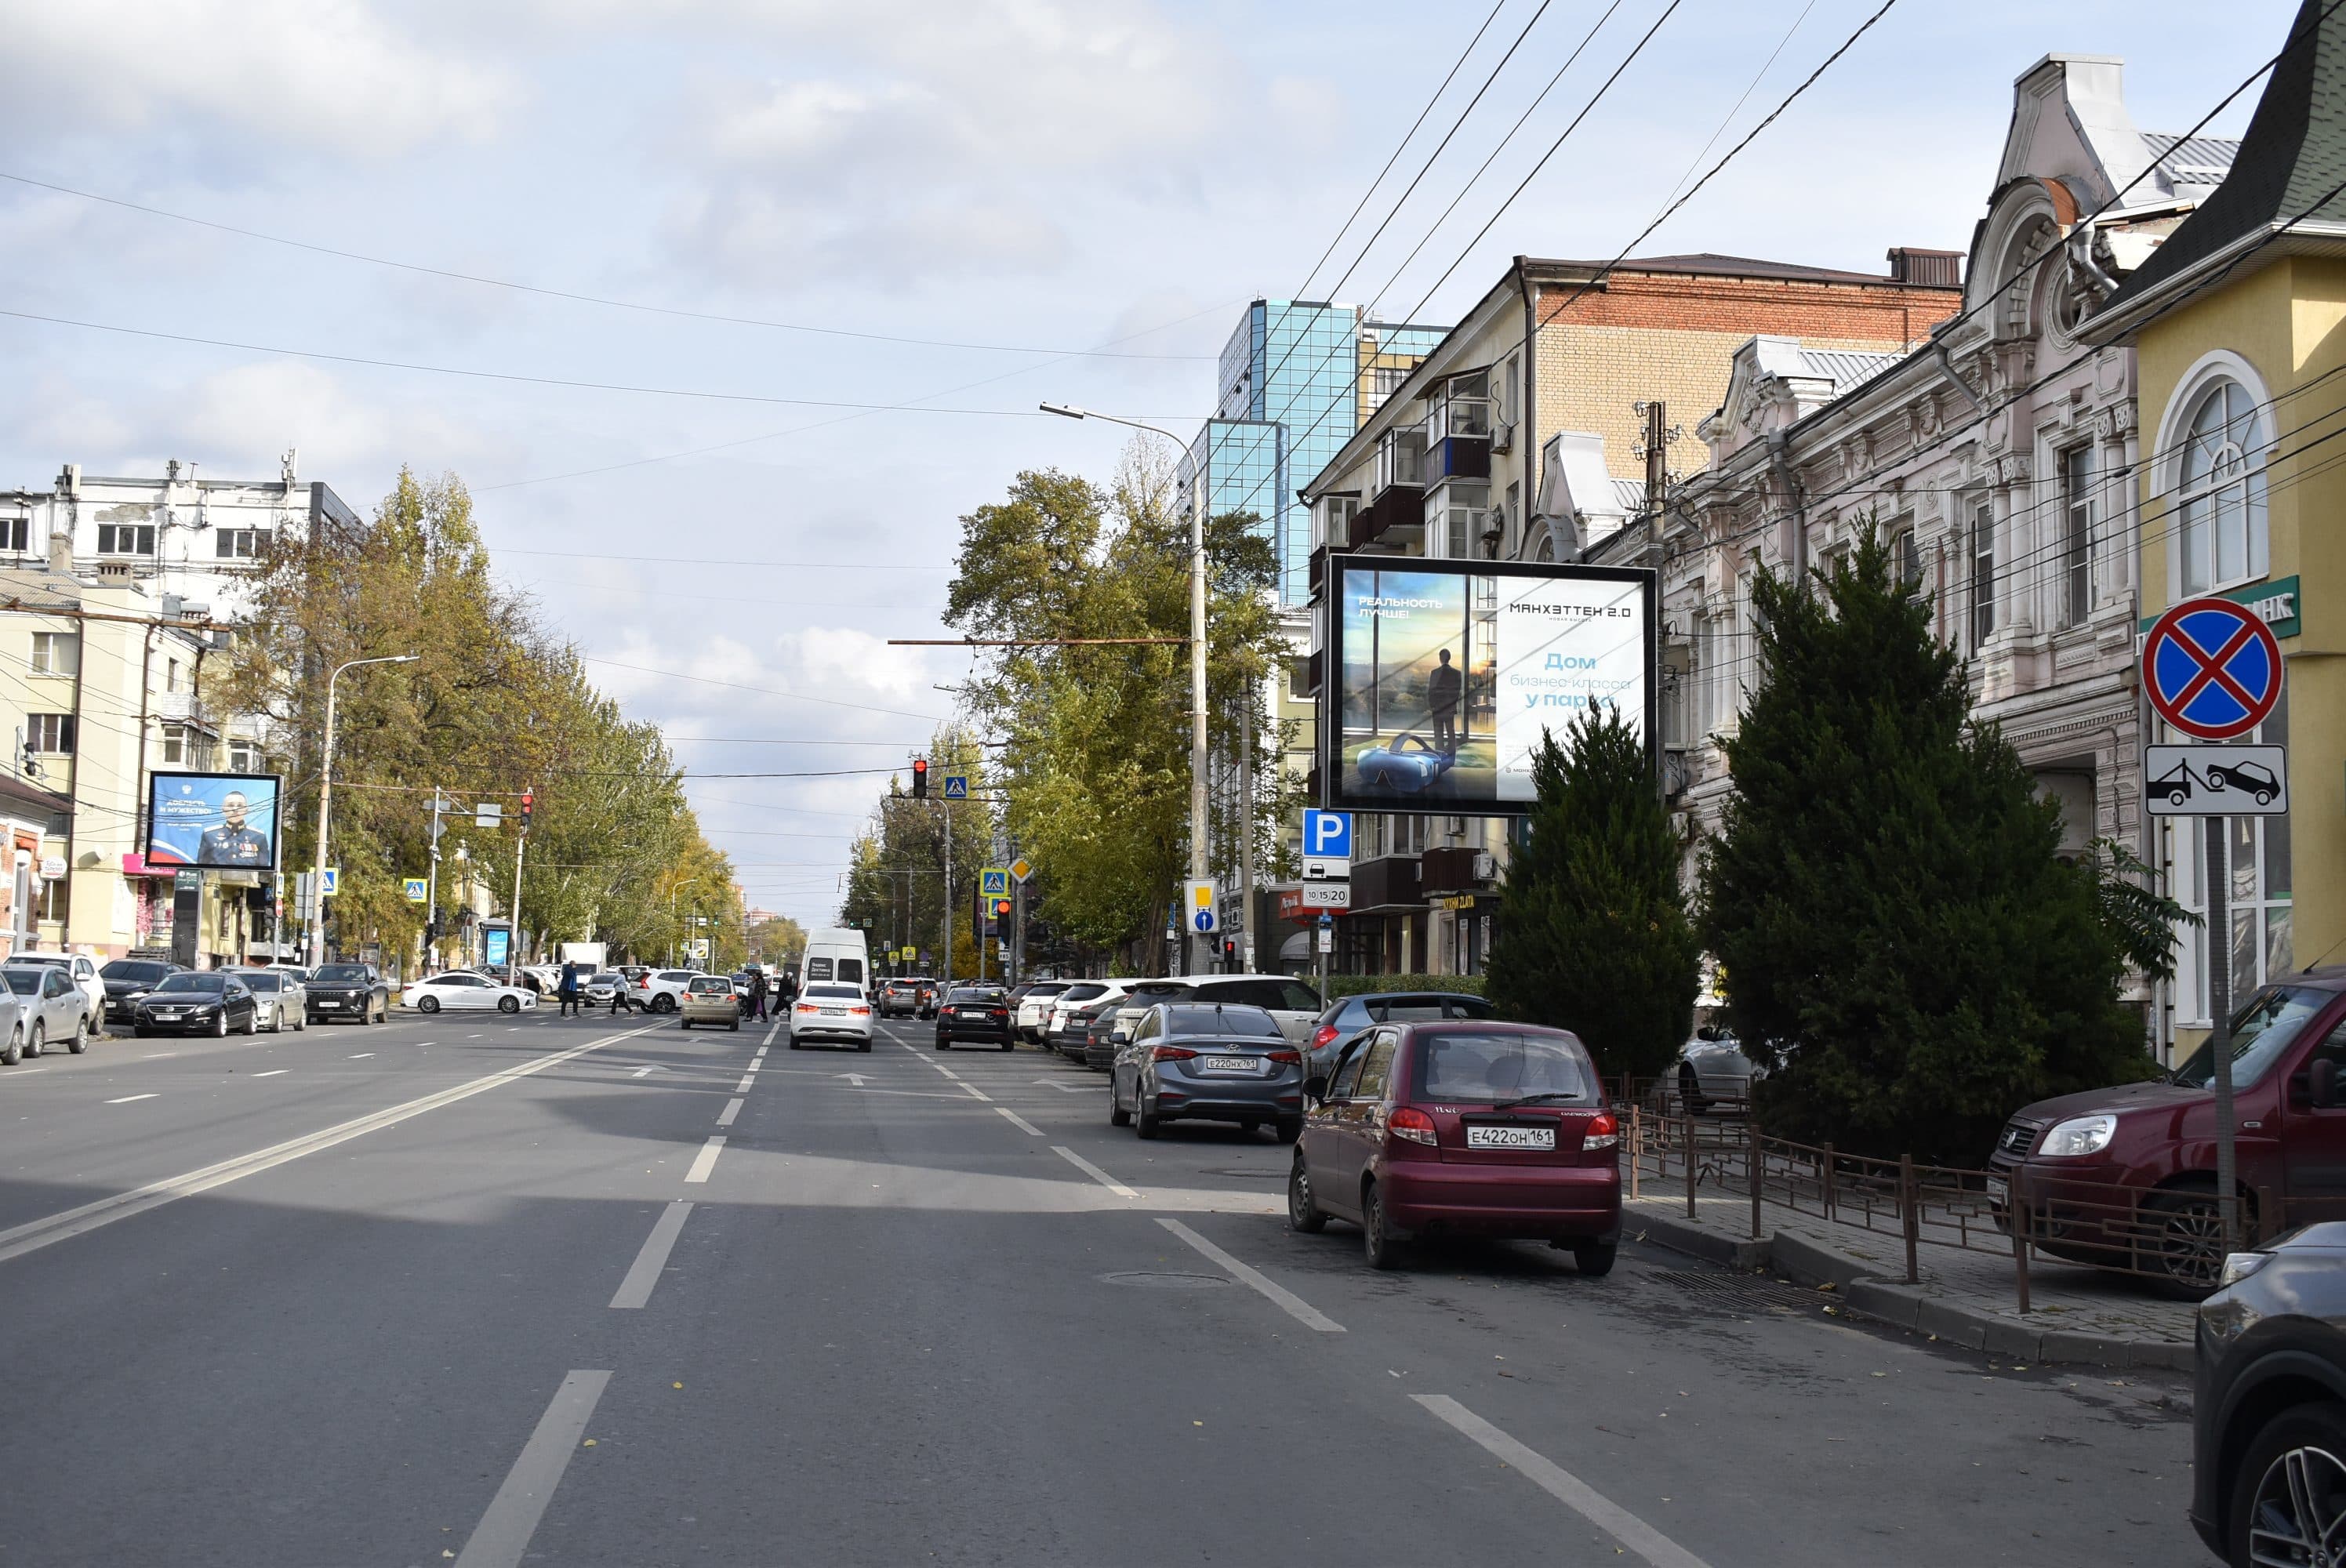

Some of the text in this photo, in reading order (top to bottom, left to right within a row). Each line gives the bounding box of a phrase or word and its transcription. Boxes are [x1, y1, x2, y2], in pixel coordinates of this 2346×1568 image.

[1359, 597, 1443, 608] РЕАЛЬНОСТЬ
[1359, 608, 1409, 619] ЛУЧШЕ!
[1509, 603, 1631, 617] МАНХЭТТЕН 2.0
[1545, 653, 1596, 671] Дом
[1525, 694, 1539, 709] у
[1316, 815, 1343, 851] P
[1331, 891, 1346, 901] 20
[1459, 895, 1474, 909] ZLATA
